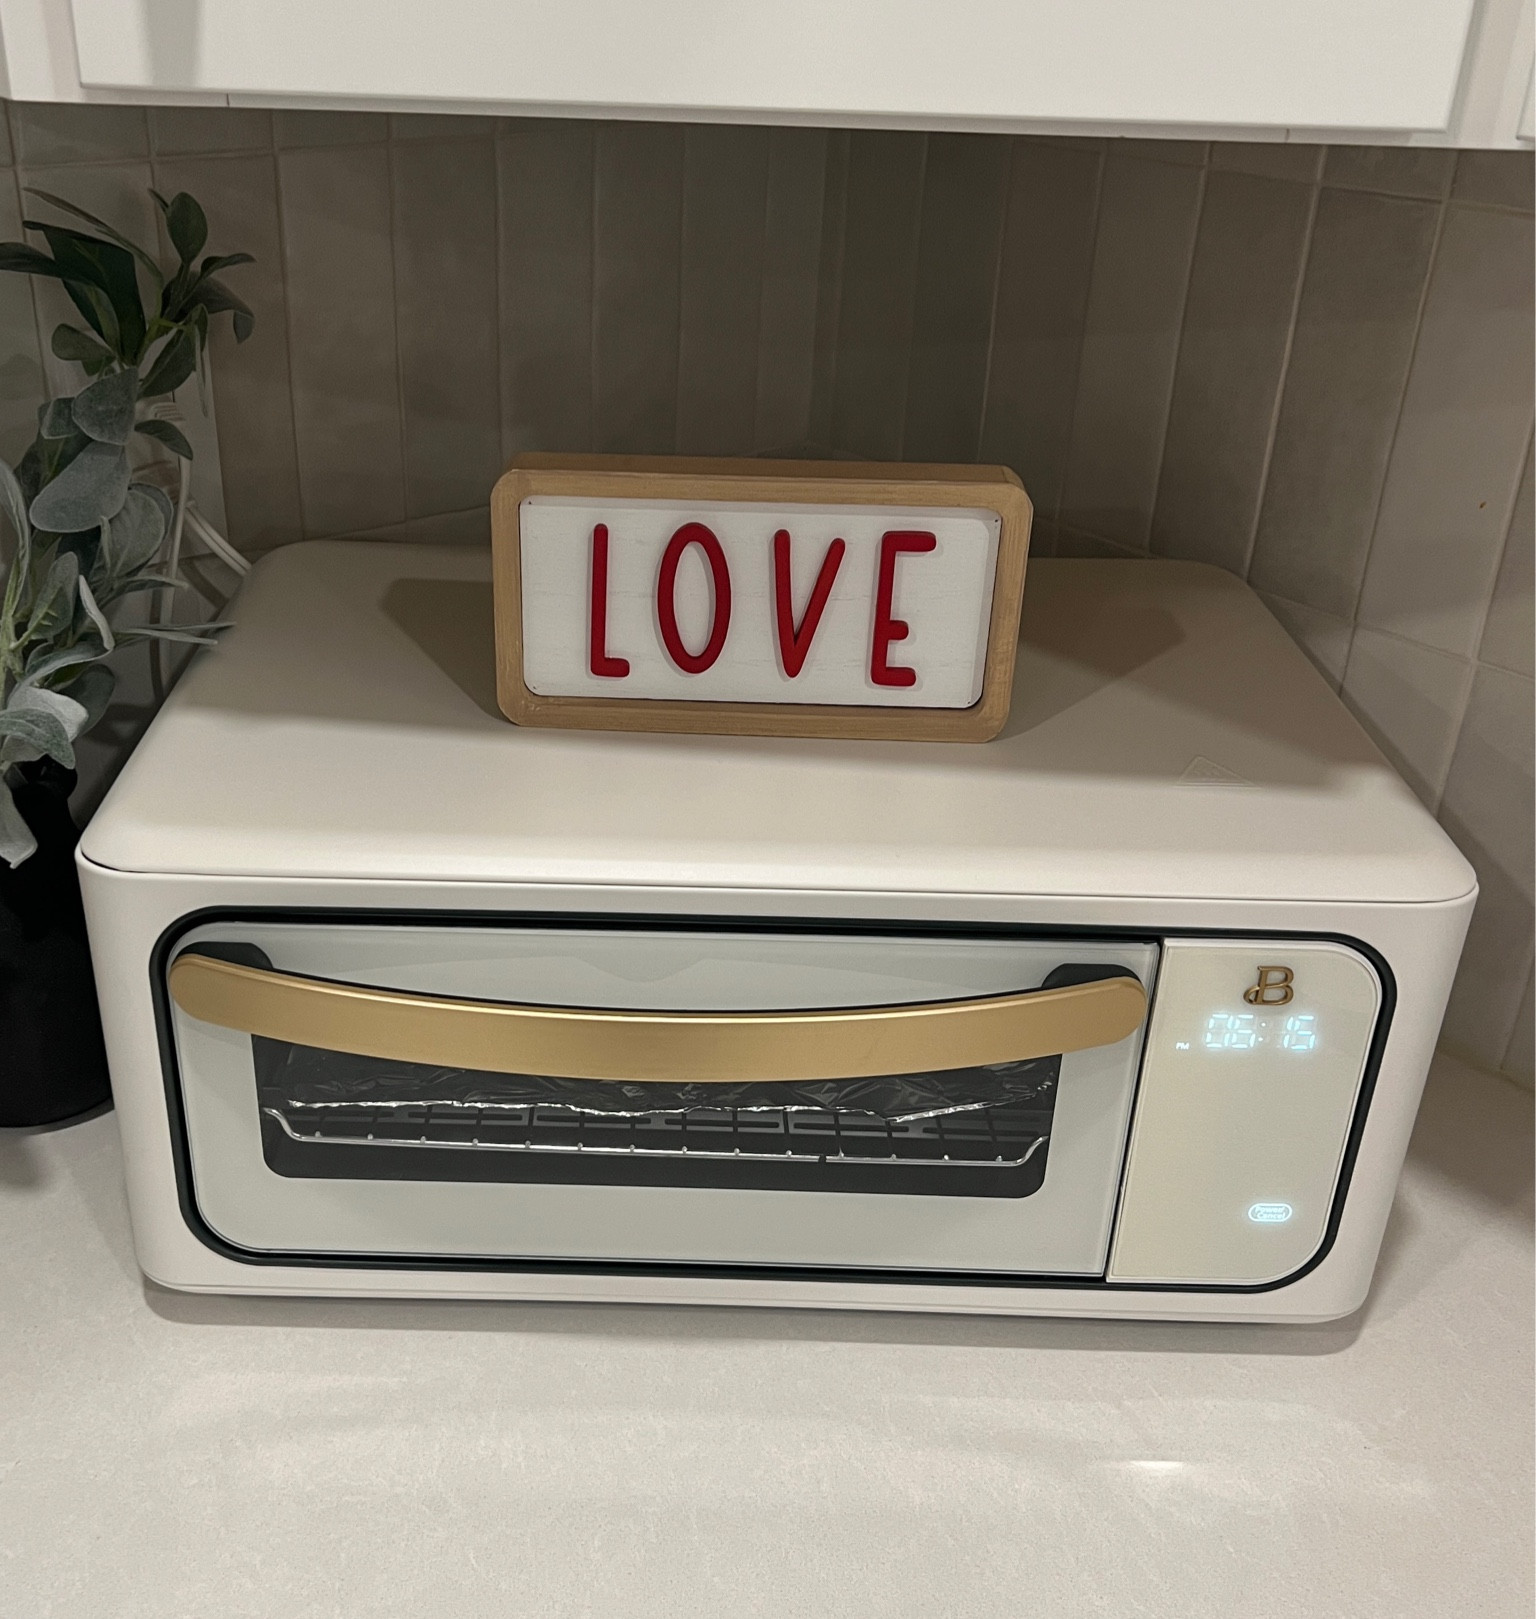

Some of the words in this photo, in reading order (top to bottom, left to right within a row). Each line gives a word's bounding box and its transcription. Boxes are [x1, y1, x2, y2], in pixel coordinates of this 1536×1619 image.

[590, 522, 937, 687] LOVE
[1242, 965, 1294, 1006] B
[1175, 1041, 1189, 1050] PM
[1205, 1013, 1316, 1050] 06:15
